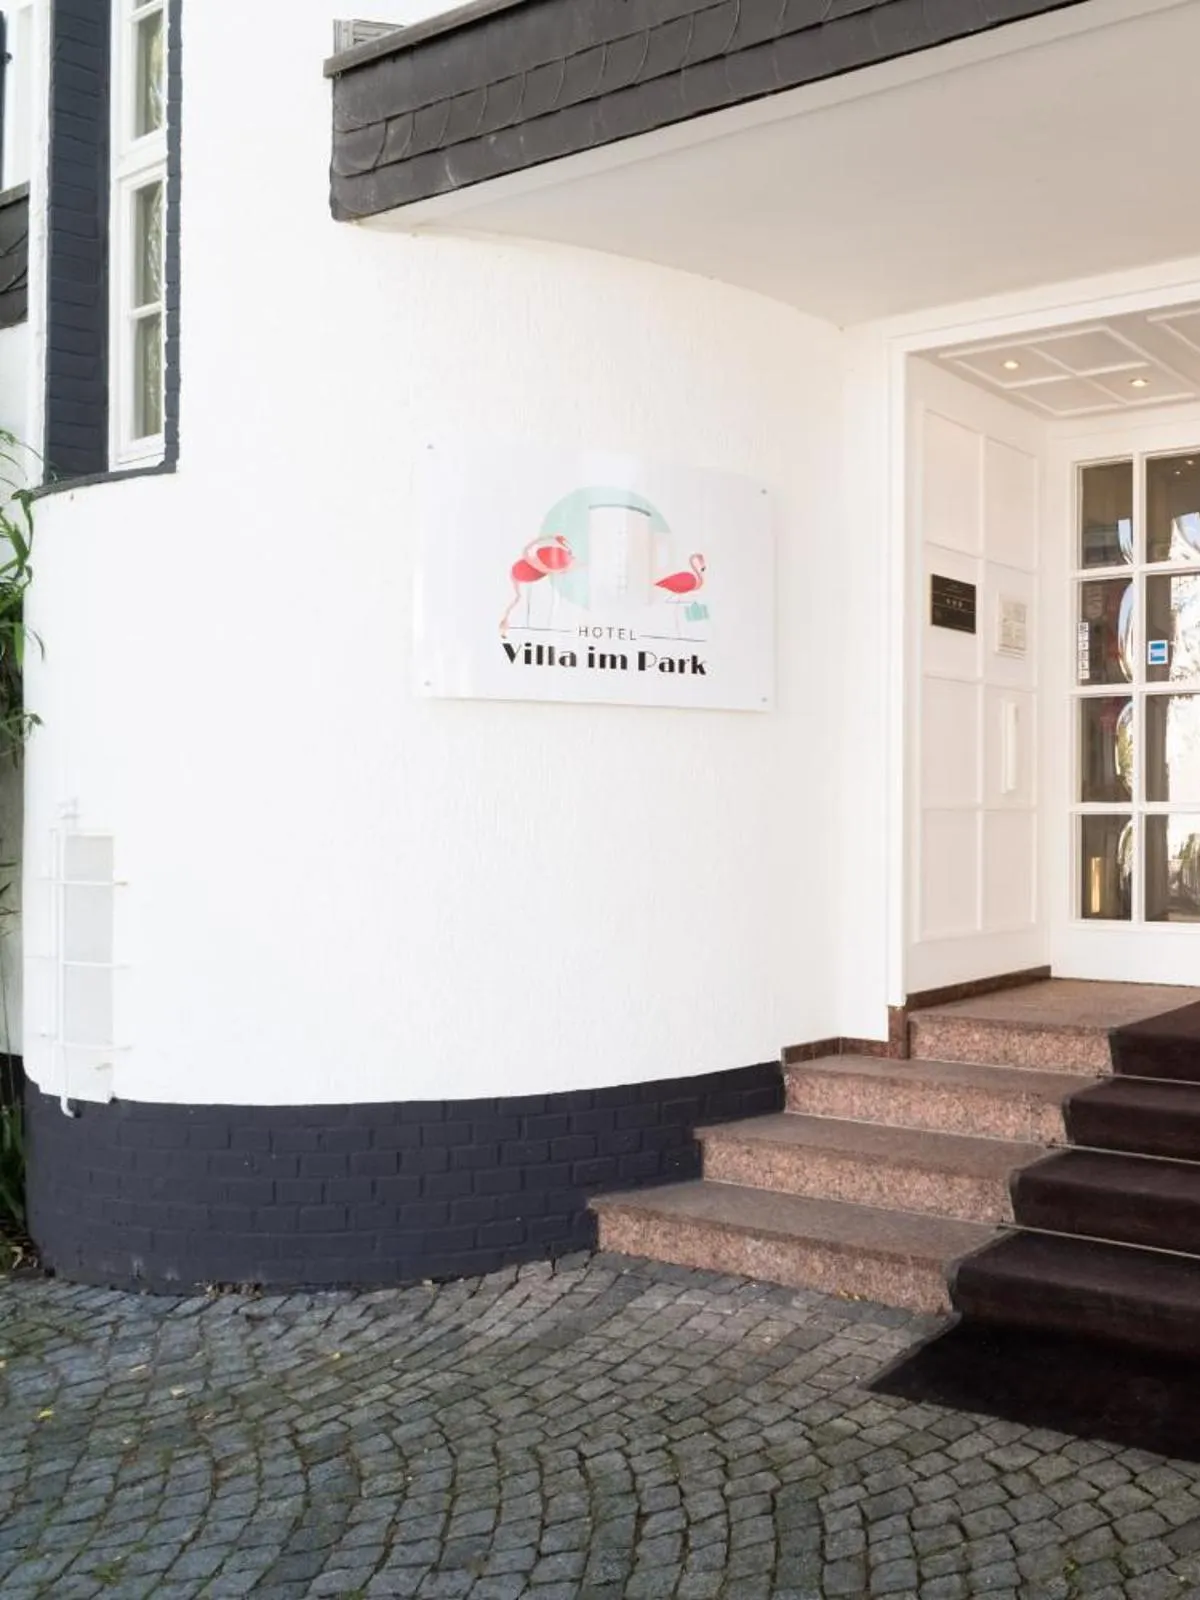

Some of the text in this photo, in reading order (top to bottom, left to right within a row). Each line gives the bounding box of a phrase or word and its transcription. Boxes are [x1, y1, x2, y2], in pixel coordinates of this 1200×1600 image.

[578, 626, 637, 641] HOTEL
[503, 642, 707, 675] Villa im Park
